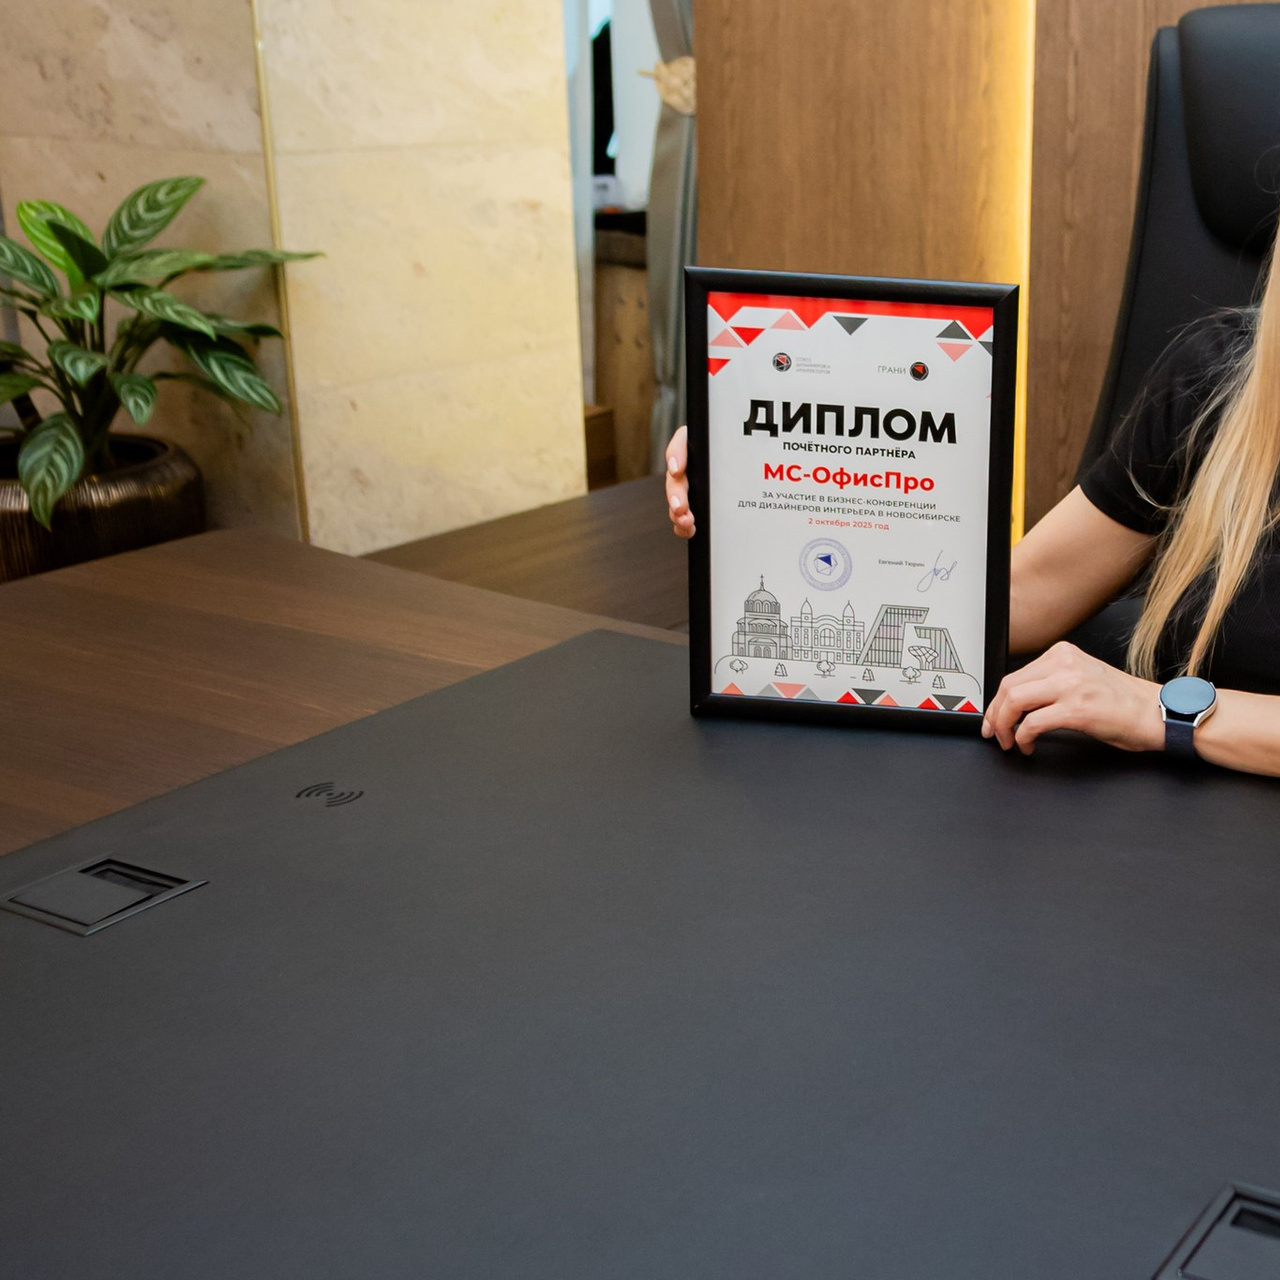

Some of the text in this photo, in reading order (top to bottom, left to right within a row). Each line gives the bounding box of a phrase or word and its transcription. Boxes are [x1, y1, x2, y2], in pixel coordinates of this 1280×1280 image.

[877, 365, 906, 375] ГРАНИ
[743, 399, 957, 444] ДИПЛОМ
[783, 440, 916, 460] ПОЧЁТНОГО ПАРТНЁРА
[763, 462, 935, 494] МС-ОфисПро
[762, 491, 937, 510] ЗА УЧАСТИЕ В БИЗНЕС-КОНФЕРЕНЦИИ
[737, 500, 961, 523] ДЛЯ ДИЗАЙНЕРОВ ИНТЕРЬЕРА В НОВОСИБИРСКЕ
[815, 518, 851, 529] октября
[852, 521, 873, 530] 2025
[874, 523, 890, 531] год
